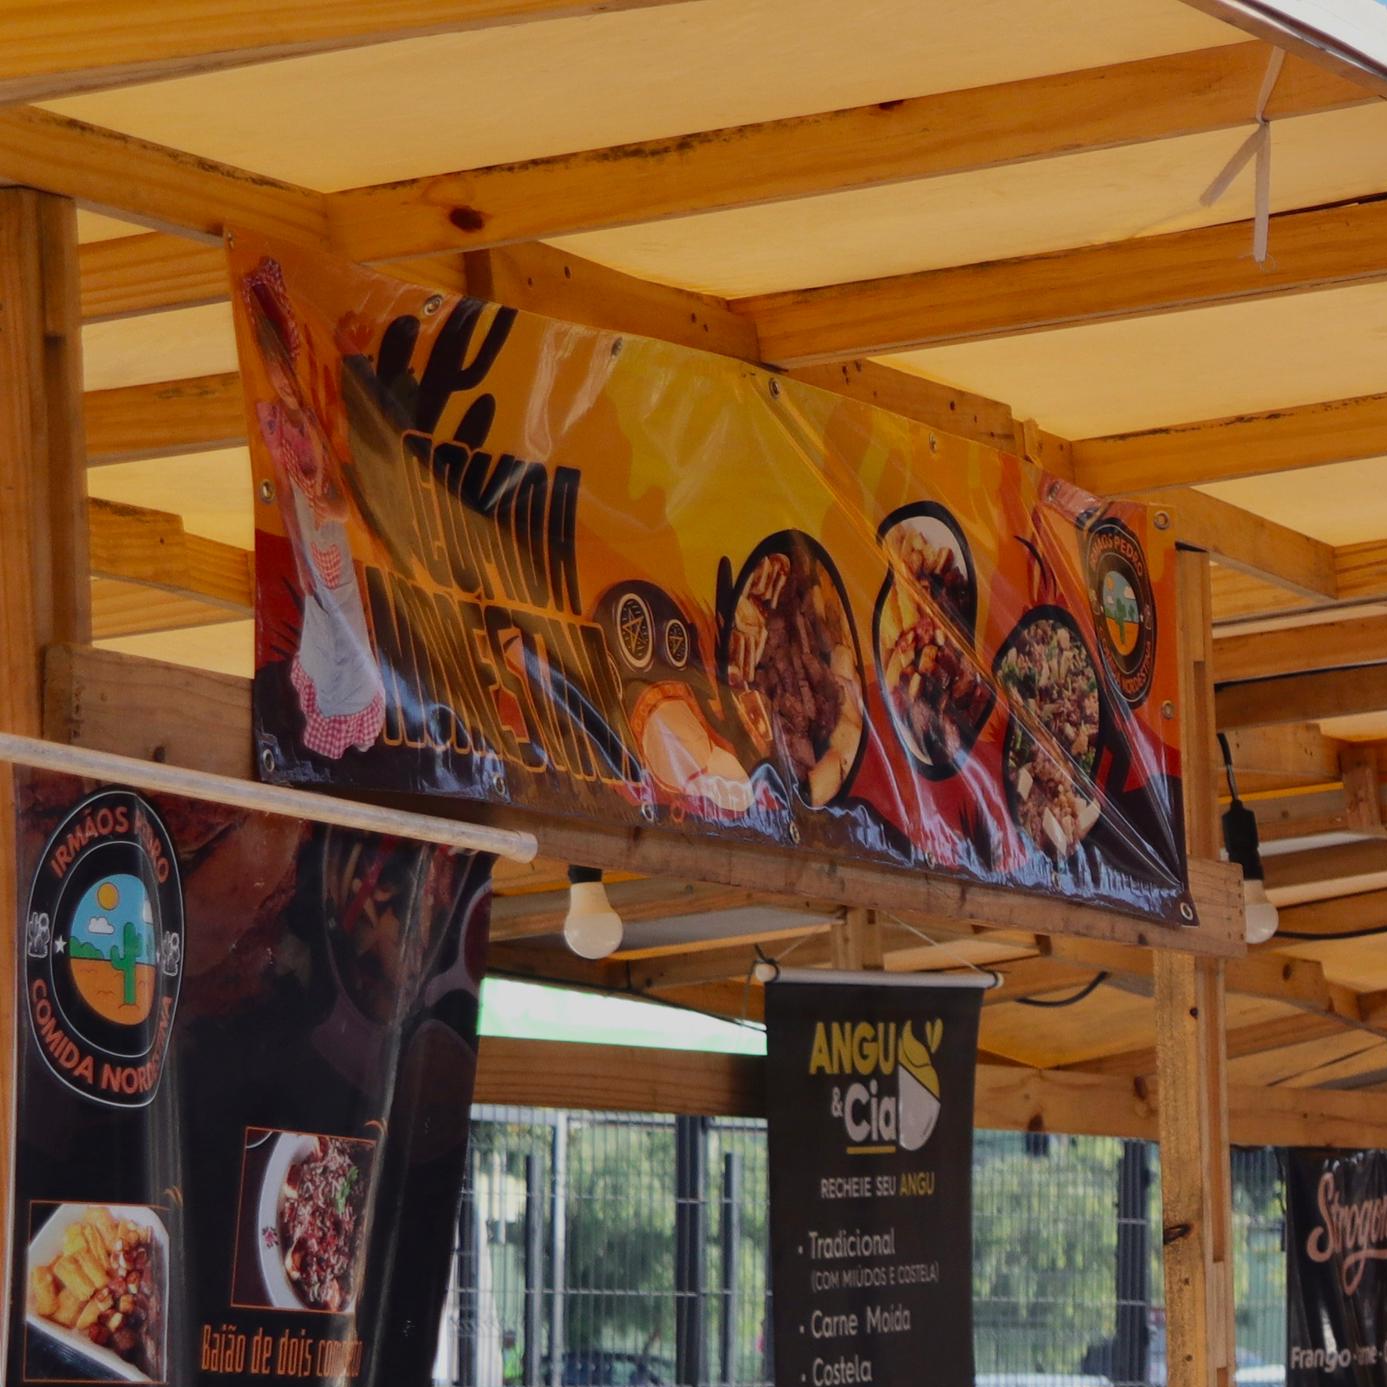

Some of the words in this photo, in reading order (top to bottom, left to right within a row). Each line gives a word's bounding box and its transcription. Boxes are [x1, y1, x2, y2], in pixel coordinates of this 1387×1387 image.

[401, 430, 582, 618] COMIDA
[51, 804, 130, 879] IRMÃOS
[31, 977, 96, 1085] COMIDA
[808, 1021, 897, 1076] ANGU
[843, 1078, 898, 1143] Cia
[820, 1176, 872, 1199] RECHEIE
[875, 1175, 897, 1197] SEU
[899, 1171, 936, 1196] ANGU
[808, 1227, 897, 1260] Tradicional
[889, 1265, 896, 1286] E
[810, 1309, 859, 1339] Carne
[201, 1323, 247, 1376] Baião
[250, 1326, 273, 1376] de
[276, 1326, 314, 1378] dois
[812, 1353, 873, 1387] Costela
[1290, 1345, 1351, 1374] Frango
